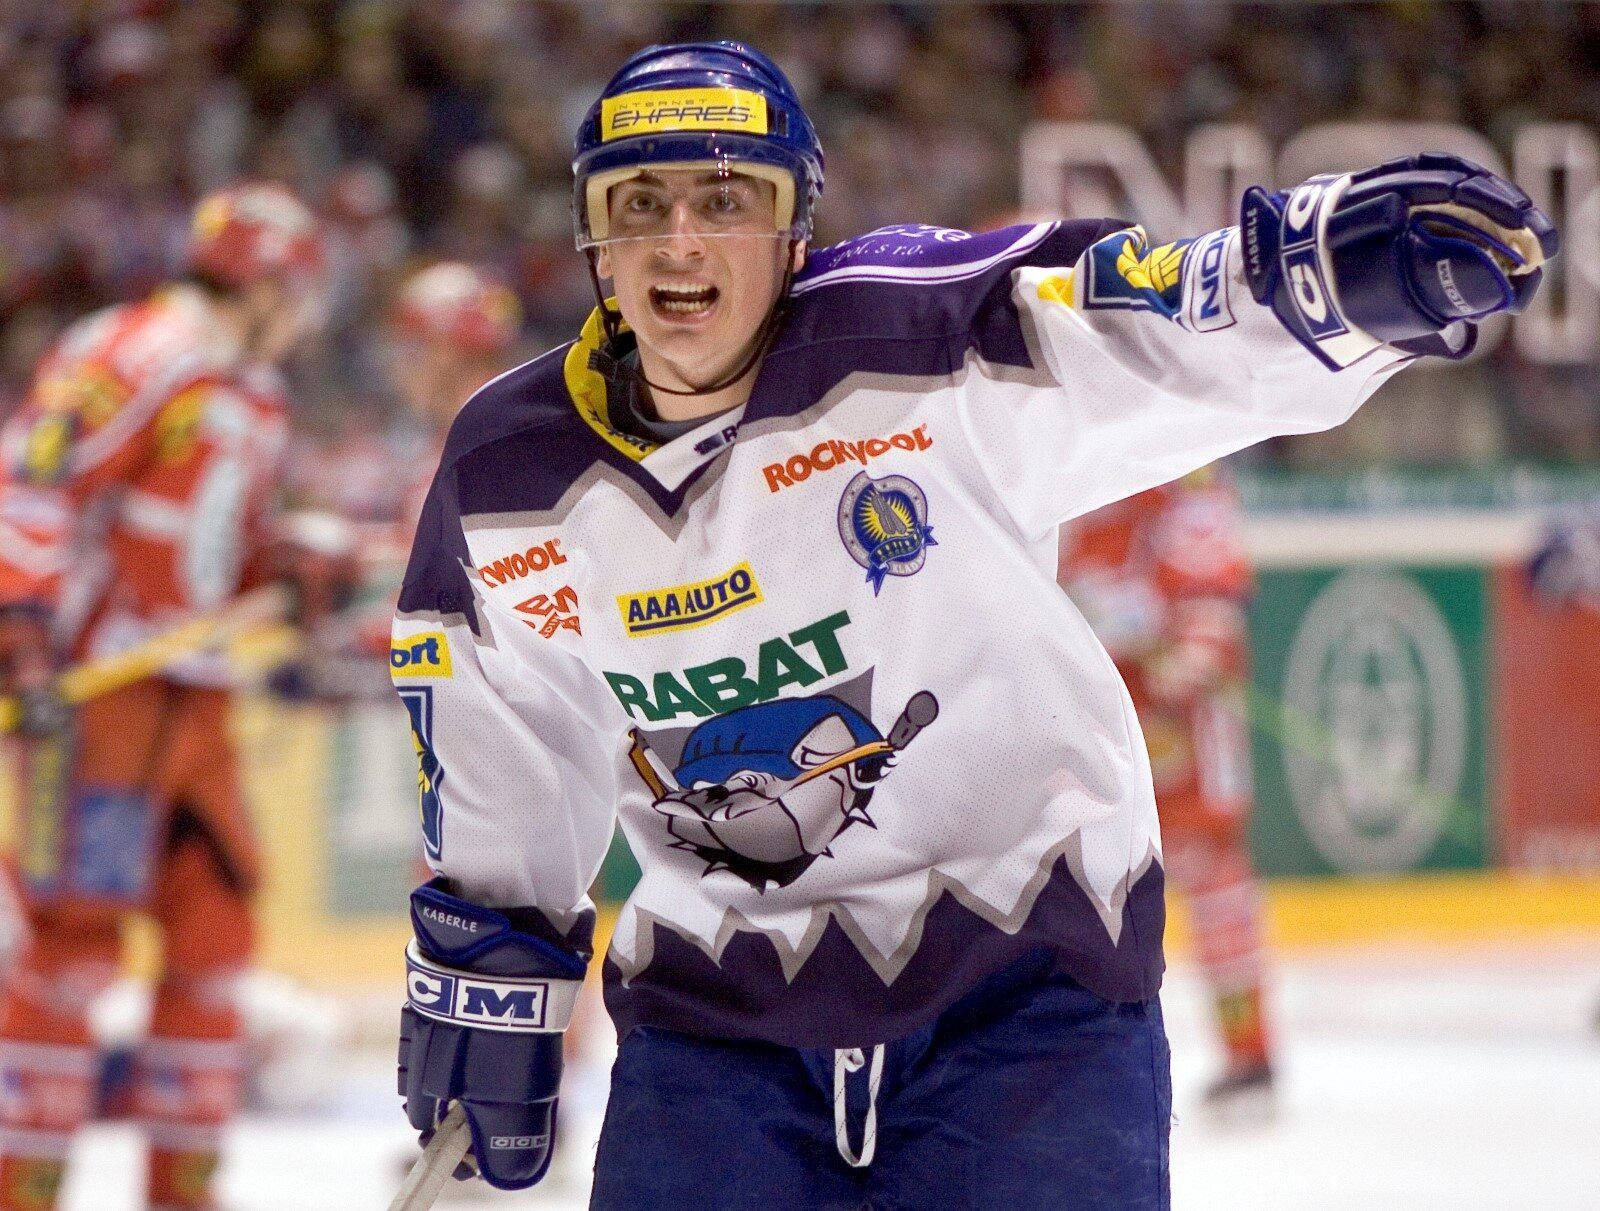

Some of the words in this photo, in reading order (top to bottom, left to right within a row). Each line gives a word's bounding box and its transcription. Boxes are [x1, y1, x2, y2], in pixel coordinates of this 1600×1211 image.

[612, 105, 750, 130] EXPRES
[1246, 207, 1261, 276] KABERLE
[602, 609, 852, 722] RABAT
[423, 905, 478, 933] KABERLE
[491, 1136, 550, 1149] CCM
